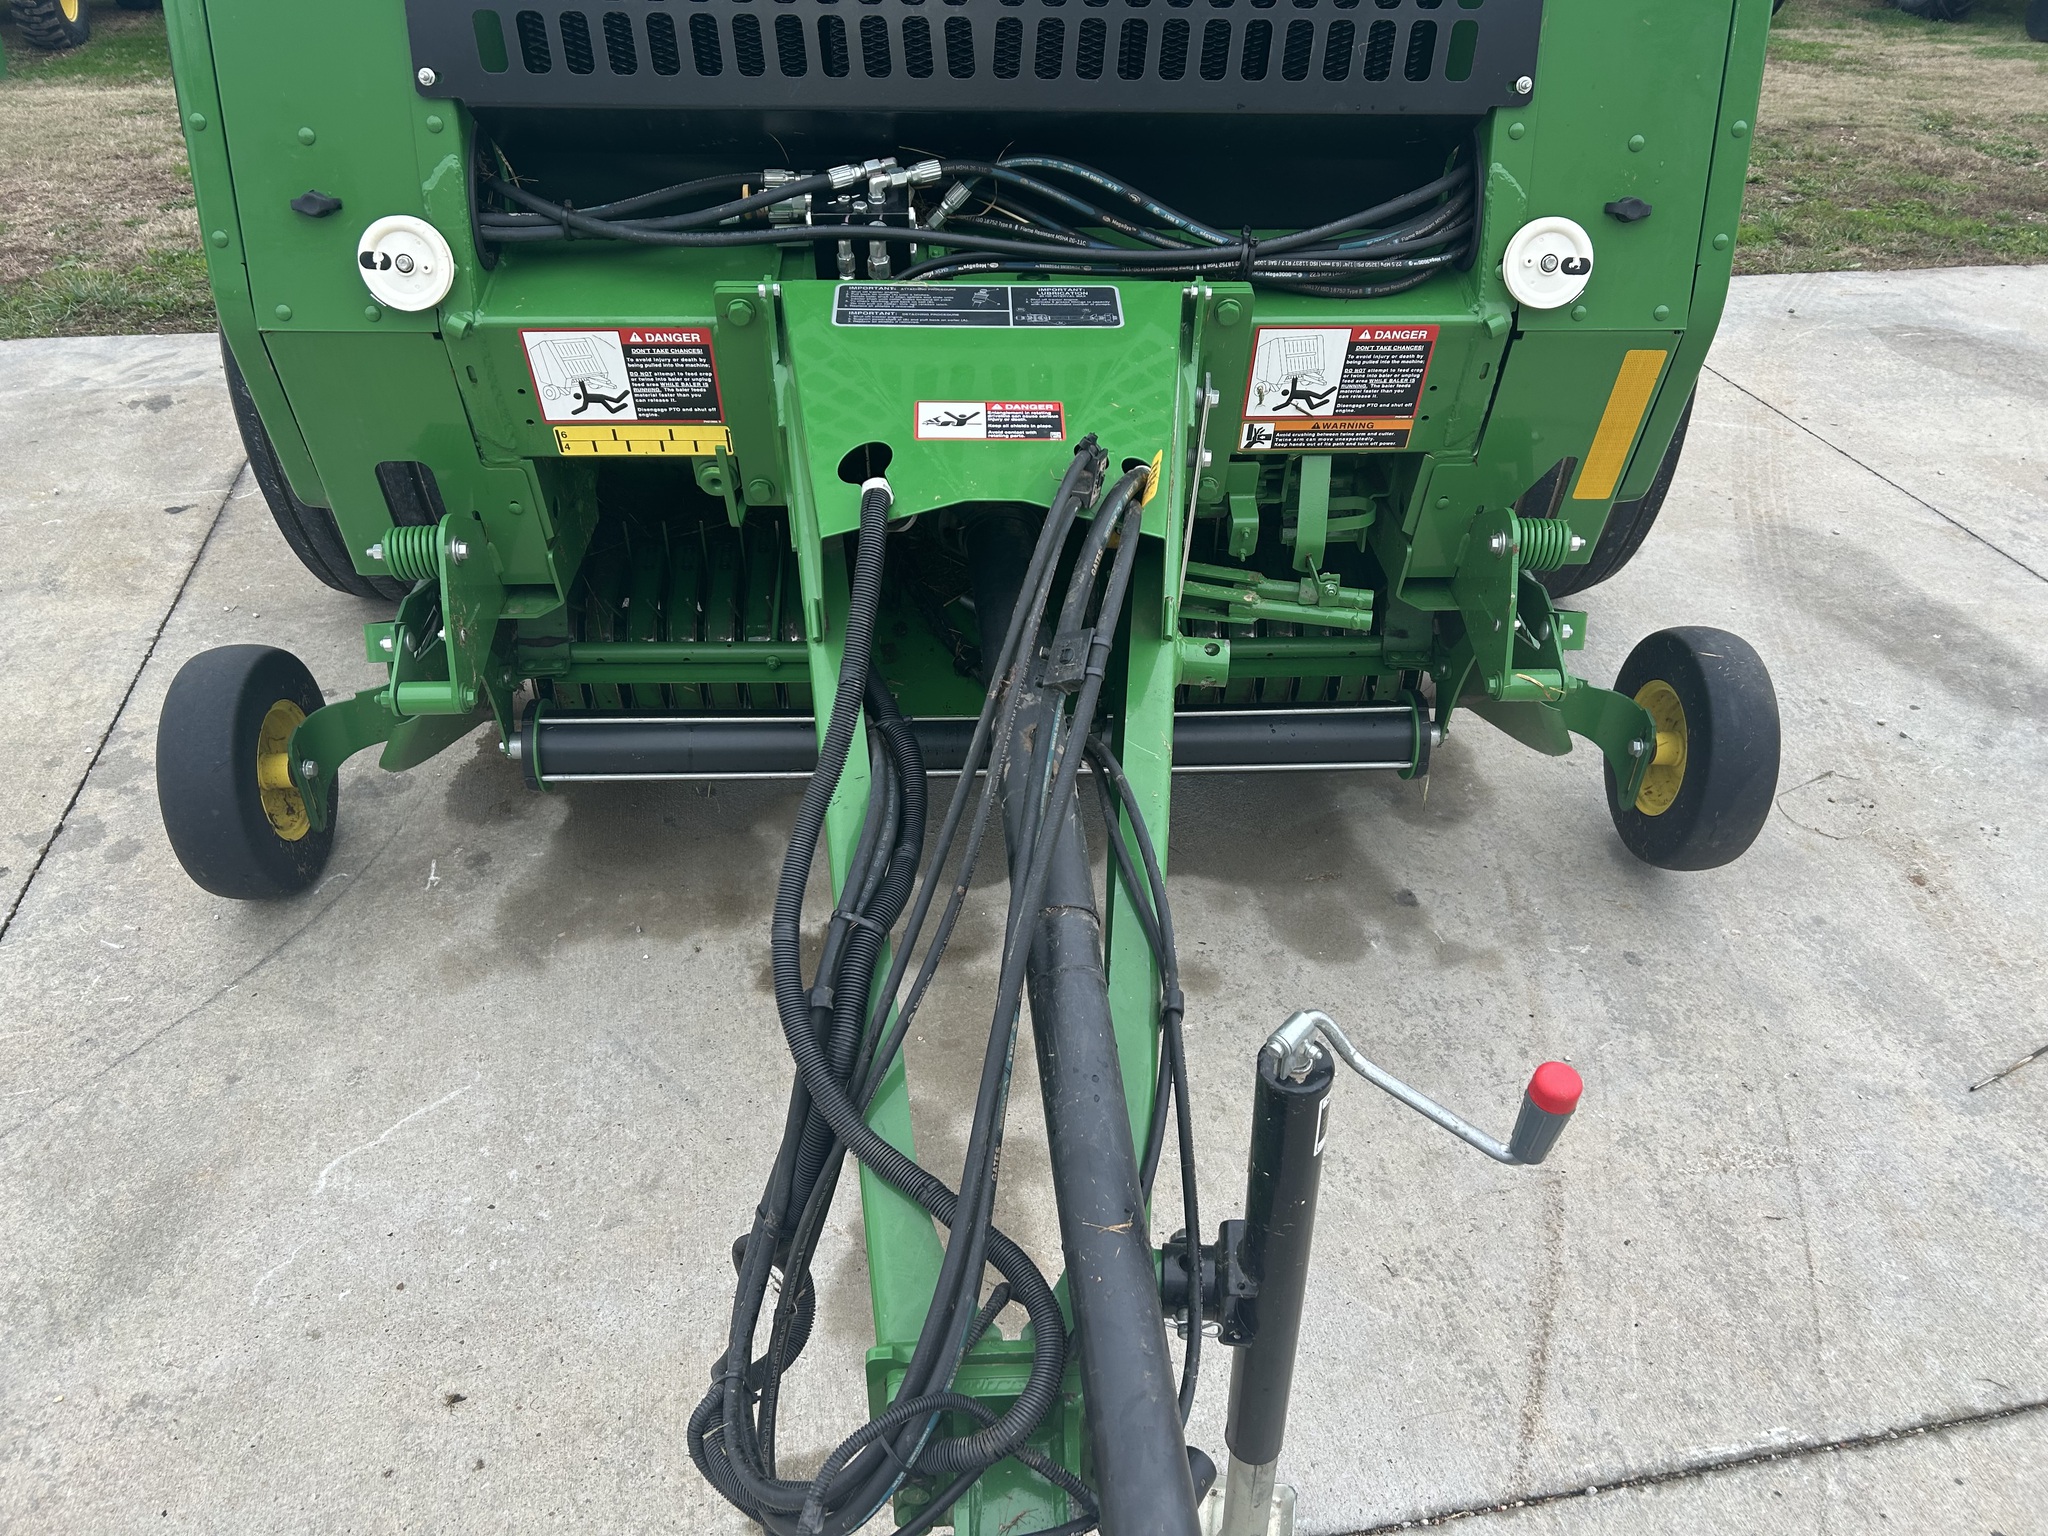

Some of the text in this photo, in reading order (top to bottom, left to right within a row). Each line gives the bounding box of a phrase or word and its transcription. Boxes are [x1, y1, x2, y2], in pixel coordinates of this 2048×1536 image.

[1020, 225, 1034, 234] Flame
[645, 333, 701, 342] DANGER
[1374, 331, 1428, 339] DANGER
[1091, 546, 1103, 576] GATES
[992, 1146, 1001, 1182] GATES
